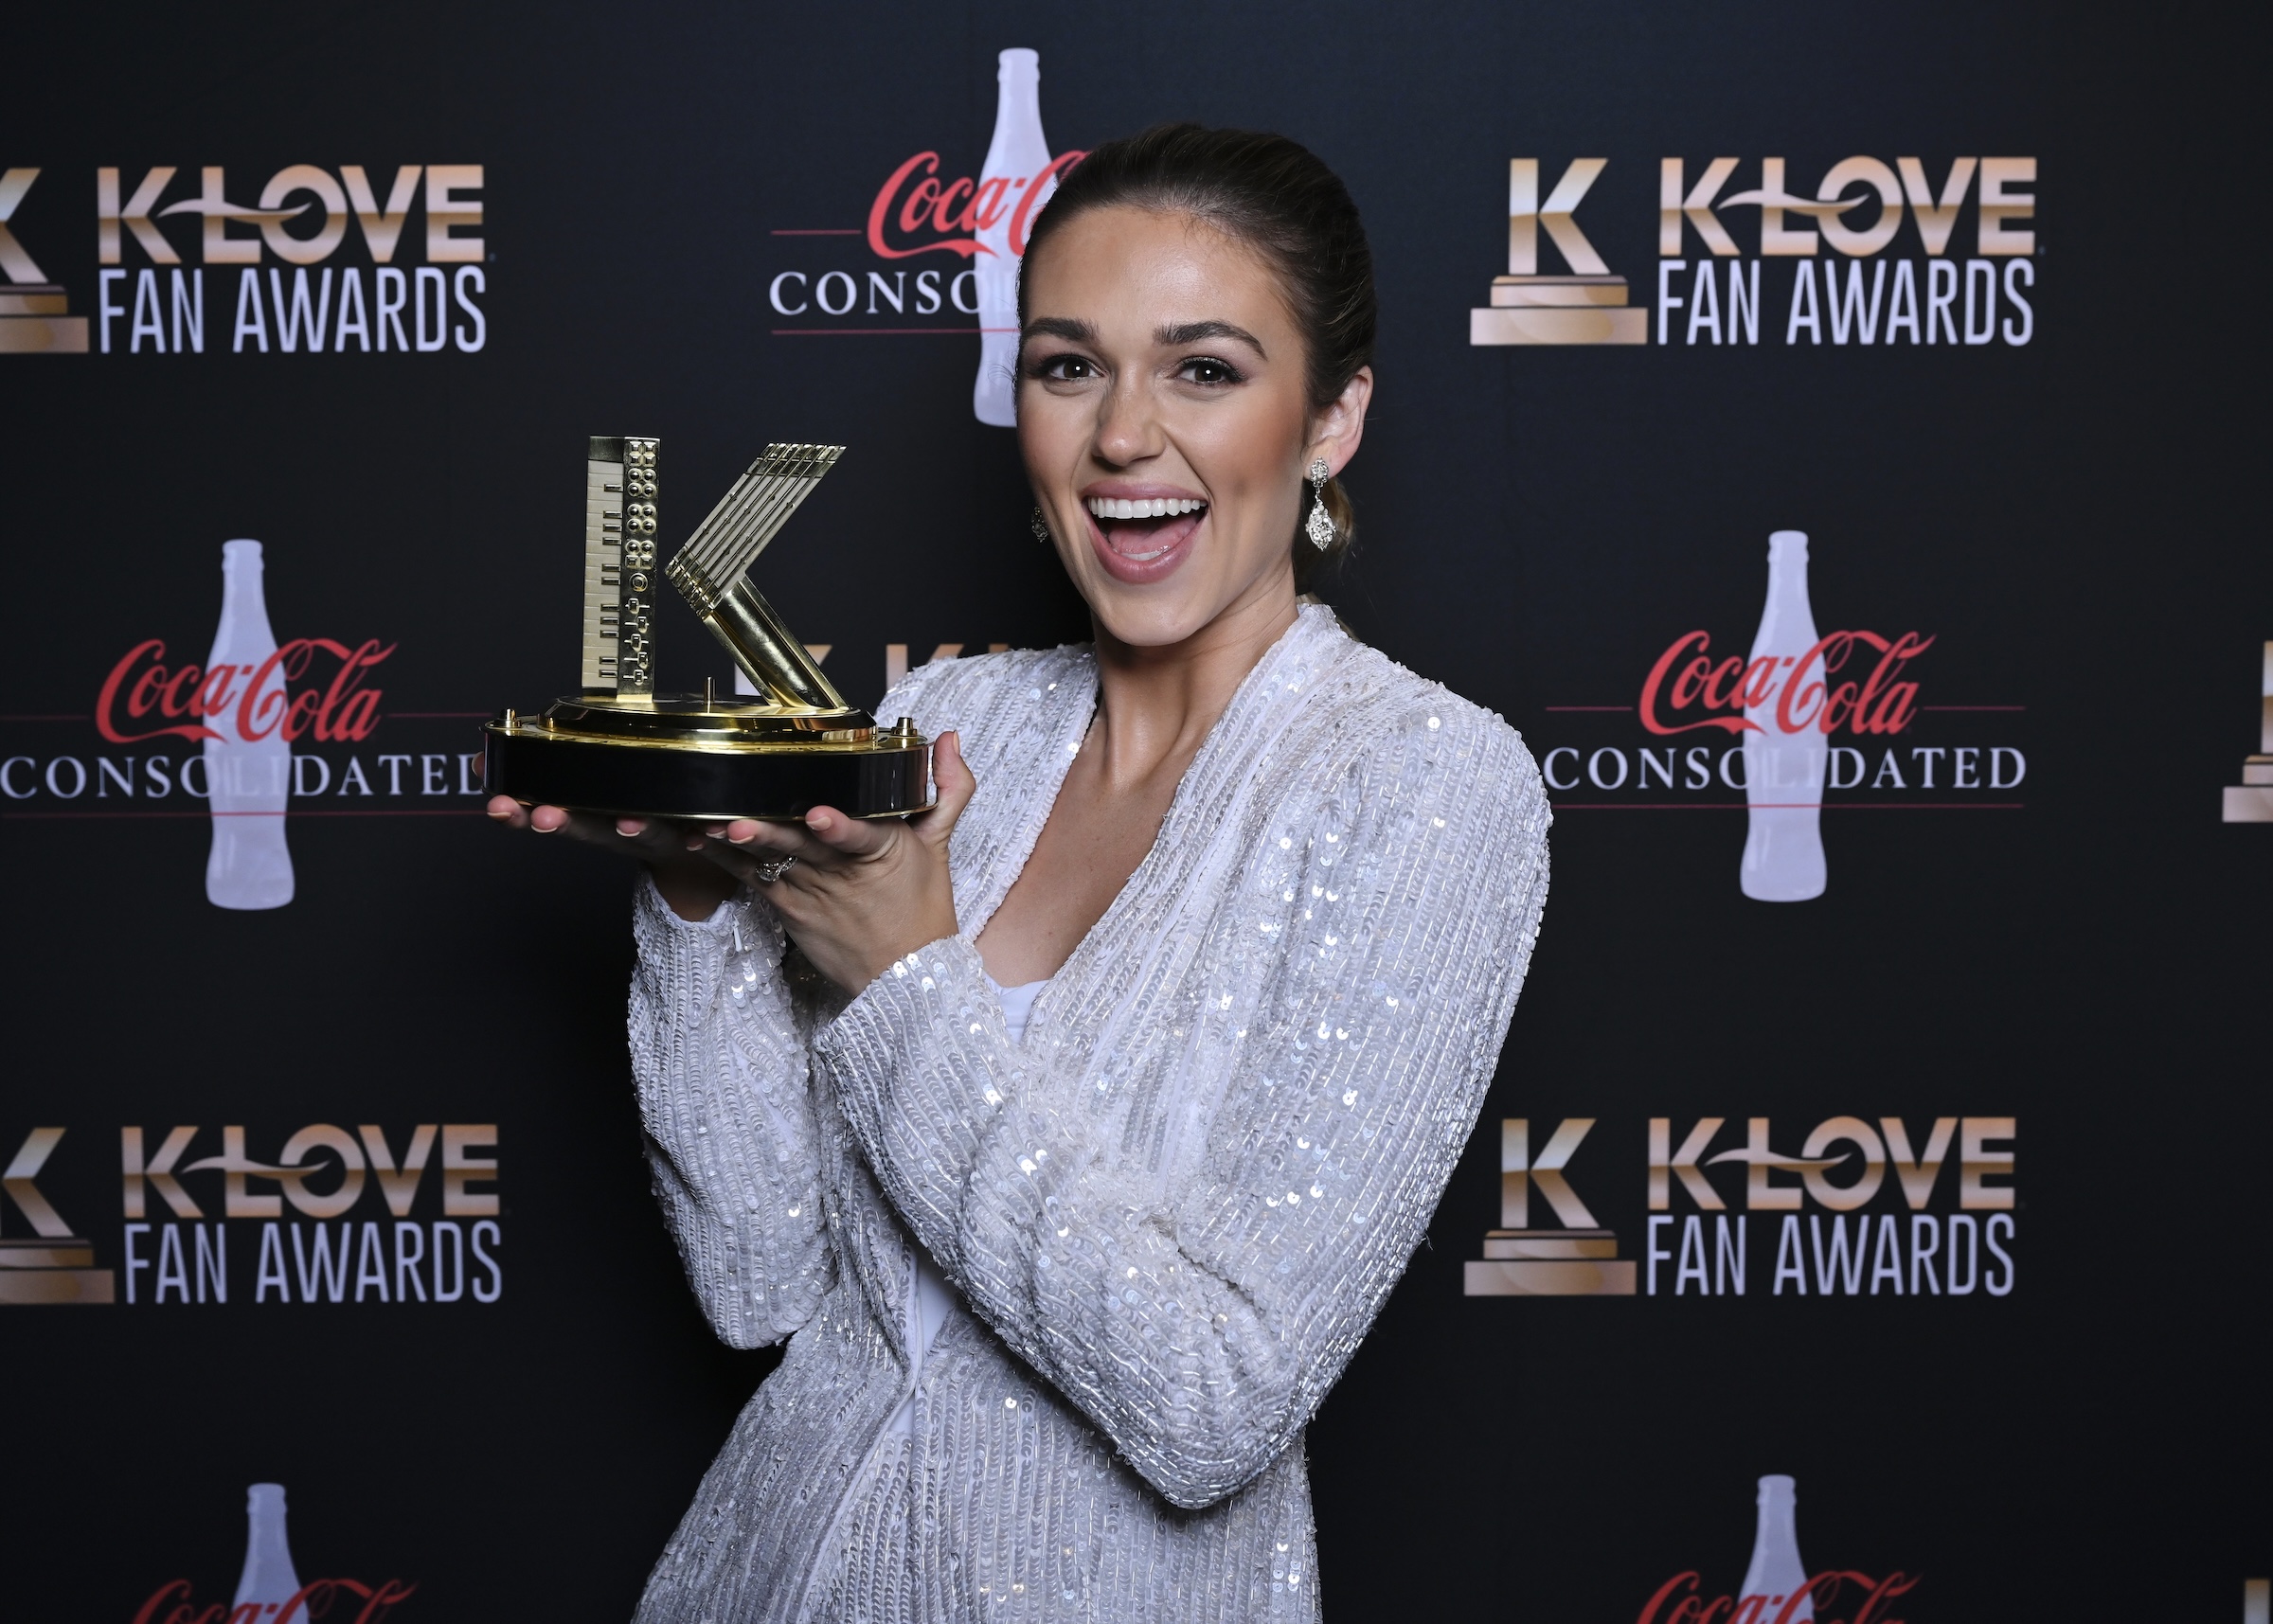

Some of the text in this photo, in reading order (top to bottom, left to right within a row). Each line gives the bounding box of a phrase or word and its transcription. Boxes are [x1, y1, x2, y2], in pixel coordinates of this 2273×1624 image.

[868, 151, 1091, 259] Coca-C
[99, 266, 486, 353] FAN AWARDS
[1657, 258, 2034, 347] FAN AWARDS
[96, 638, 398, 743] Coca-Cola
[1639, 630, 1937, 736] Coca-Cola
[1543, 747, 2026, 790] CONSOLIDATED
[125, 1220, 501, 1304] FAN AWARDS
[1647, 1213, 2014, 1296] FAN AWARDS
